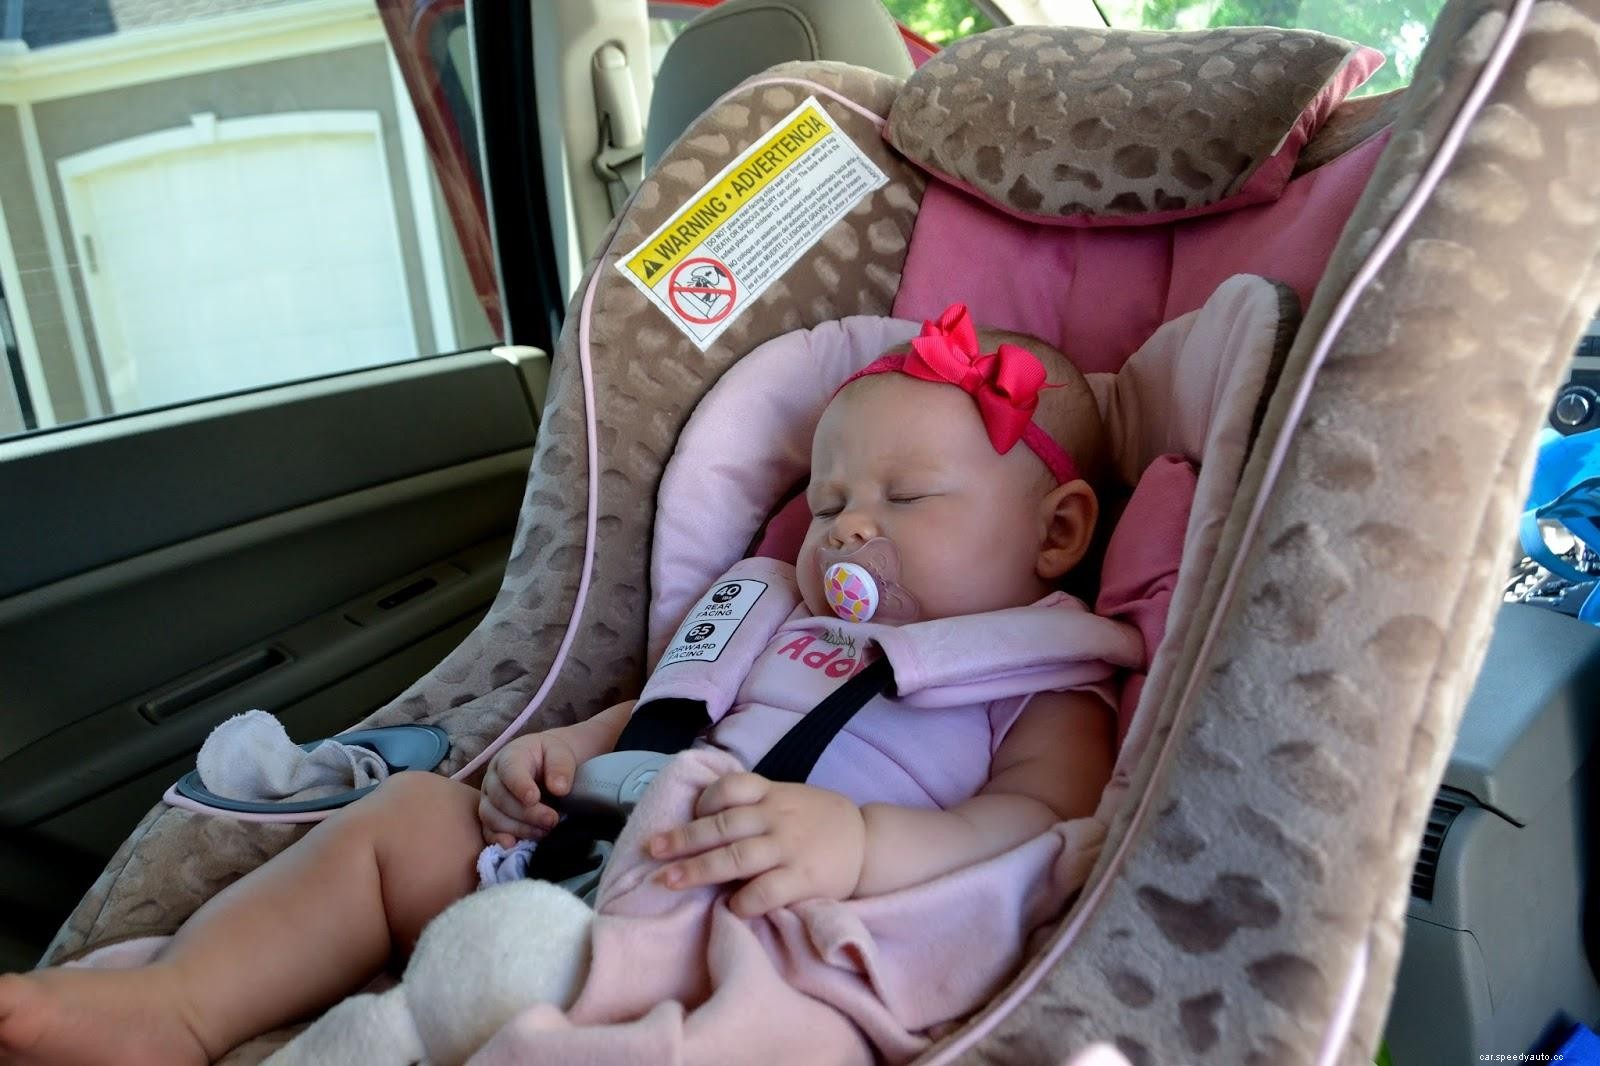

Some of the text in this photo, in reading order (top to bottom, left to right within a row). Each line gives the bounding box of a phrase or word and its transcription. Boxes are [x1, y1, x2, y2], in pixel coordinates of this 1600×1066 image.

[652, 111, 825, 263] WARNING ADVERTENCIA
[717, 586, 740, 597] 40
[689, 625, 712, 636] 65
